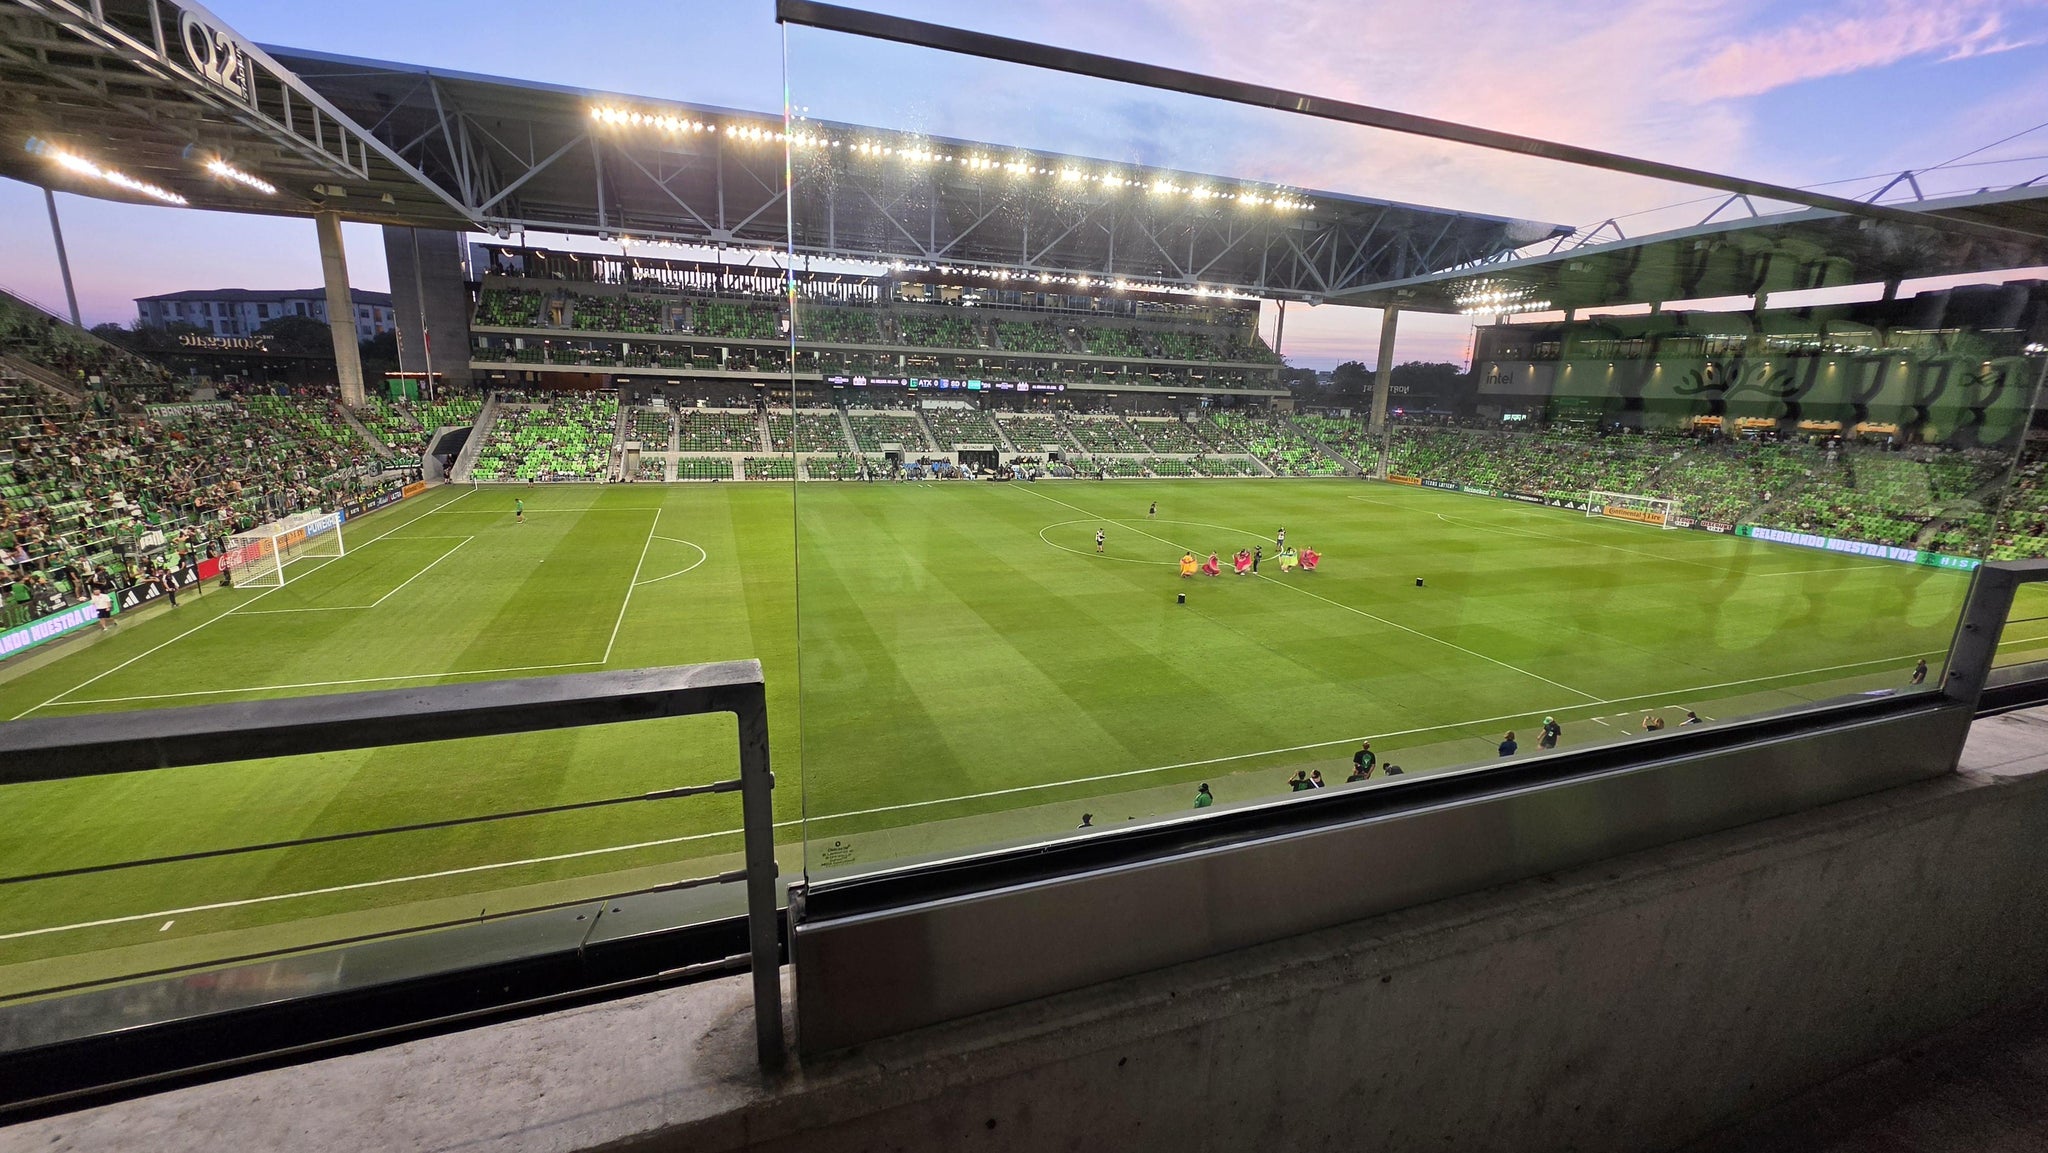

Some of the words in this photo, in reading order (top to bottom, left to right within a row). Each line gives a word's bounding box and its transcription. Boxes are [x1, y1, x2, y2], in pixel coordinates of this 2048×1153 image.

[178, 9, 243, 97] Q2
[1486, 371, 1514, 385] intel
[1463, 485, 1490, 496] Heineken
[1608, 506, 1642, 519] Continental
[1700, 520, 1733, 531] DISCOUNT
[1751, 527, 1826, 548] CELEBRANDO
[1826, 537, 1887, 558] NUESTRA
[1889, 546, 1918, 562] VOZ
[30, 609, 84, 642] NUESTRA
